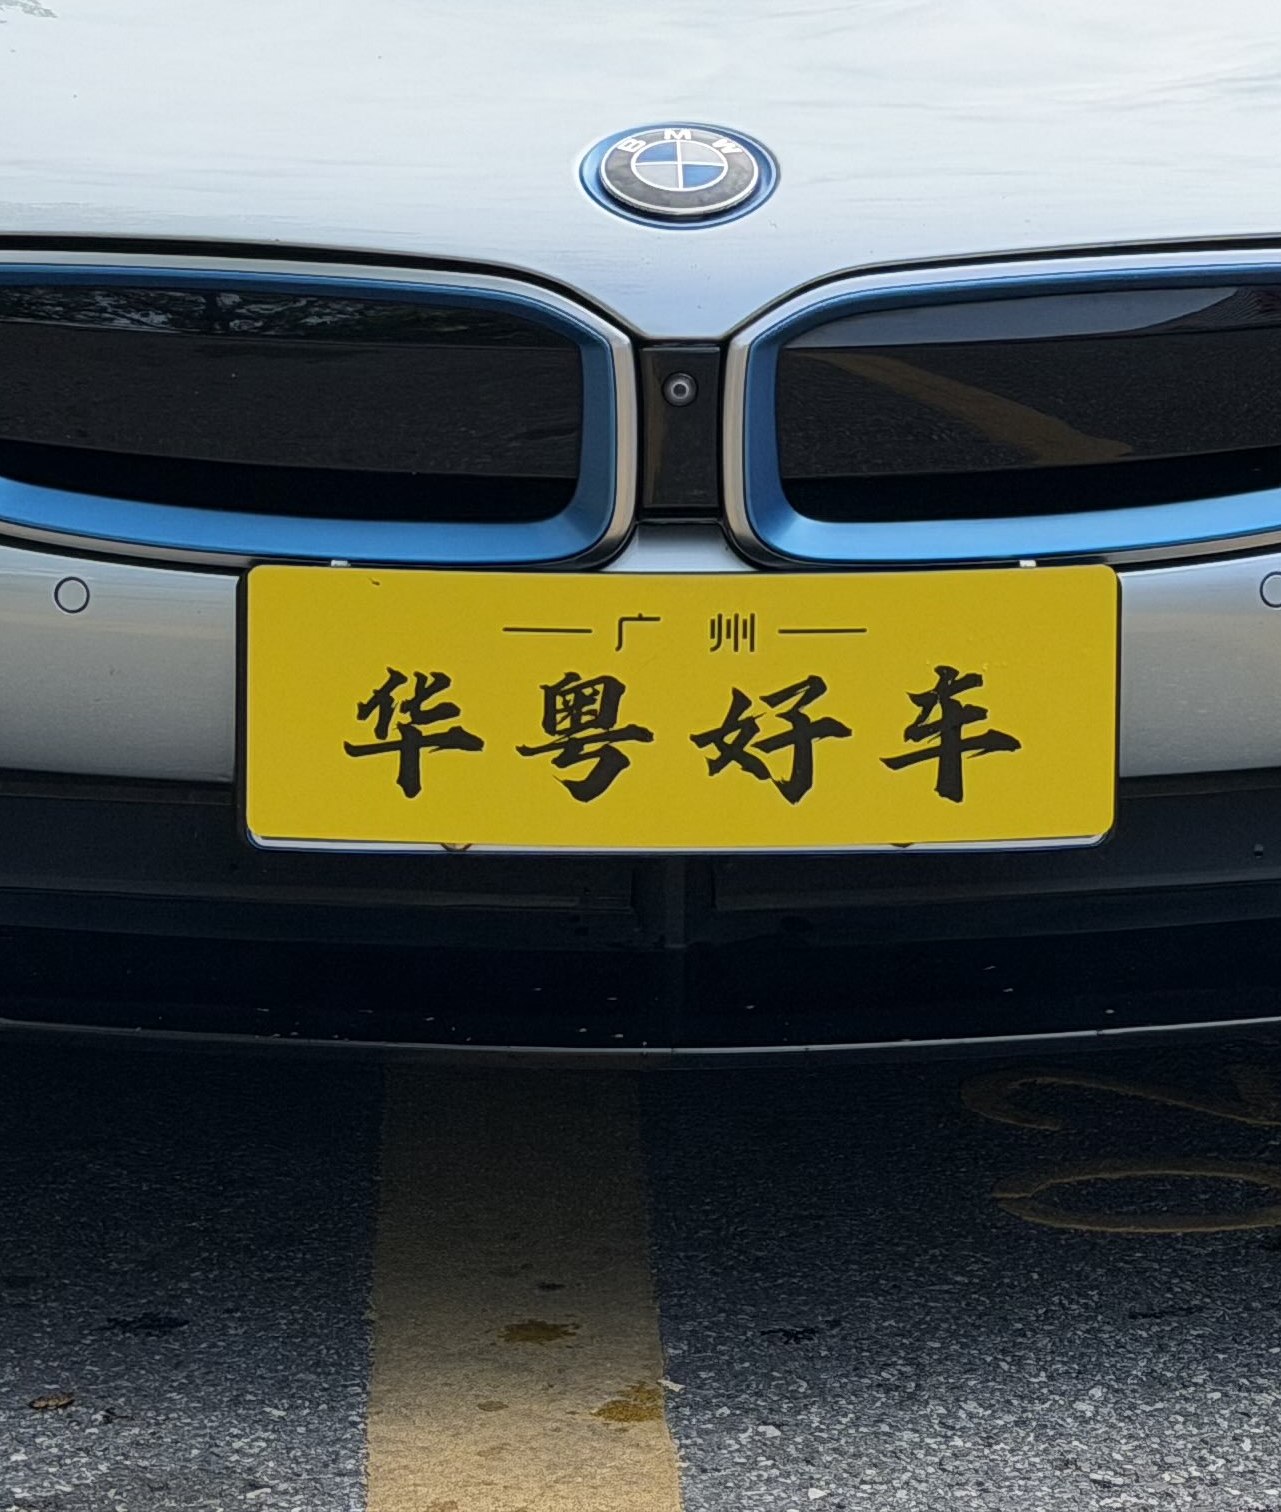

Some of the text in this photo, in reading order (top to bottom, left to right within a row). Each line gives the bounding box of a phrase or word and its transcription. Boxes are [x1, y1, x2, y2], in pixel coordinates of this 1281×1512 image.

[616, 128, 744, 154] BMW
[342, 665, 1022, 805] 华粤好车
